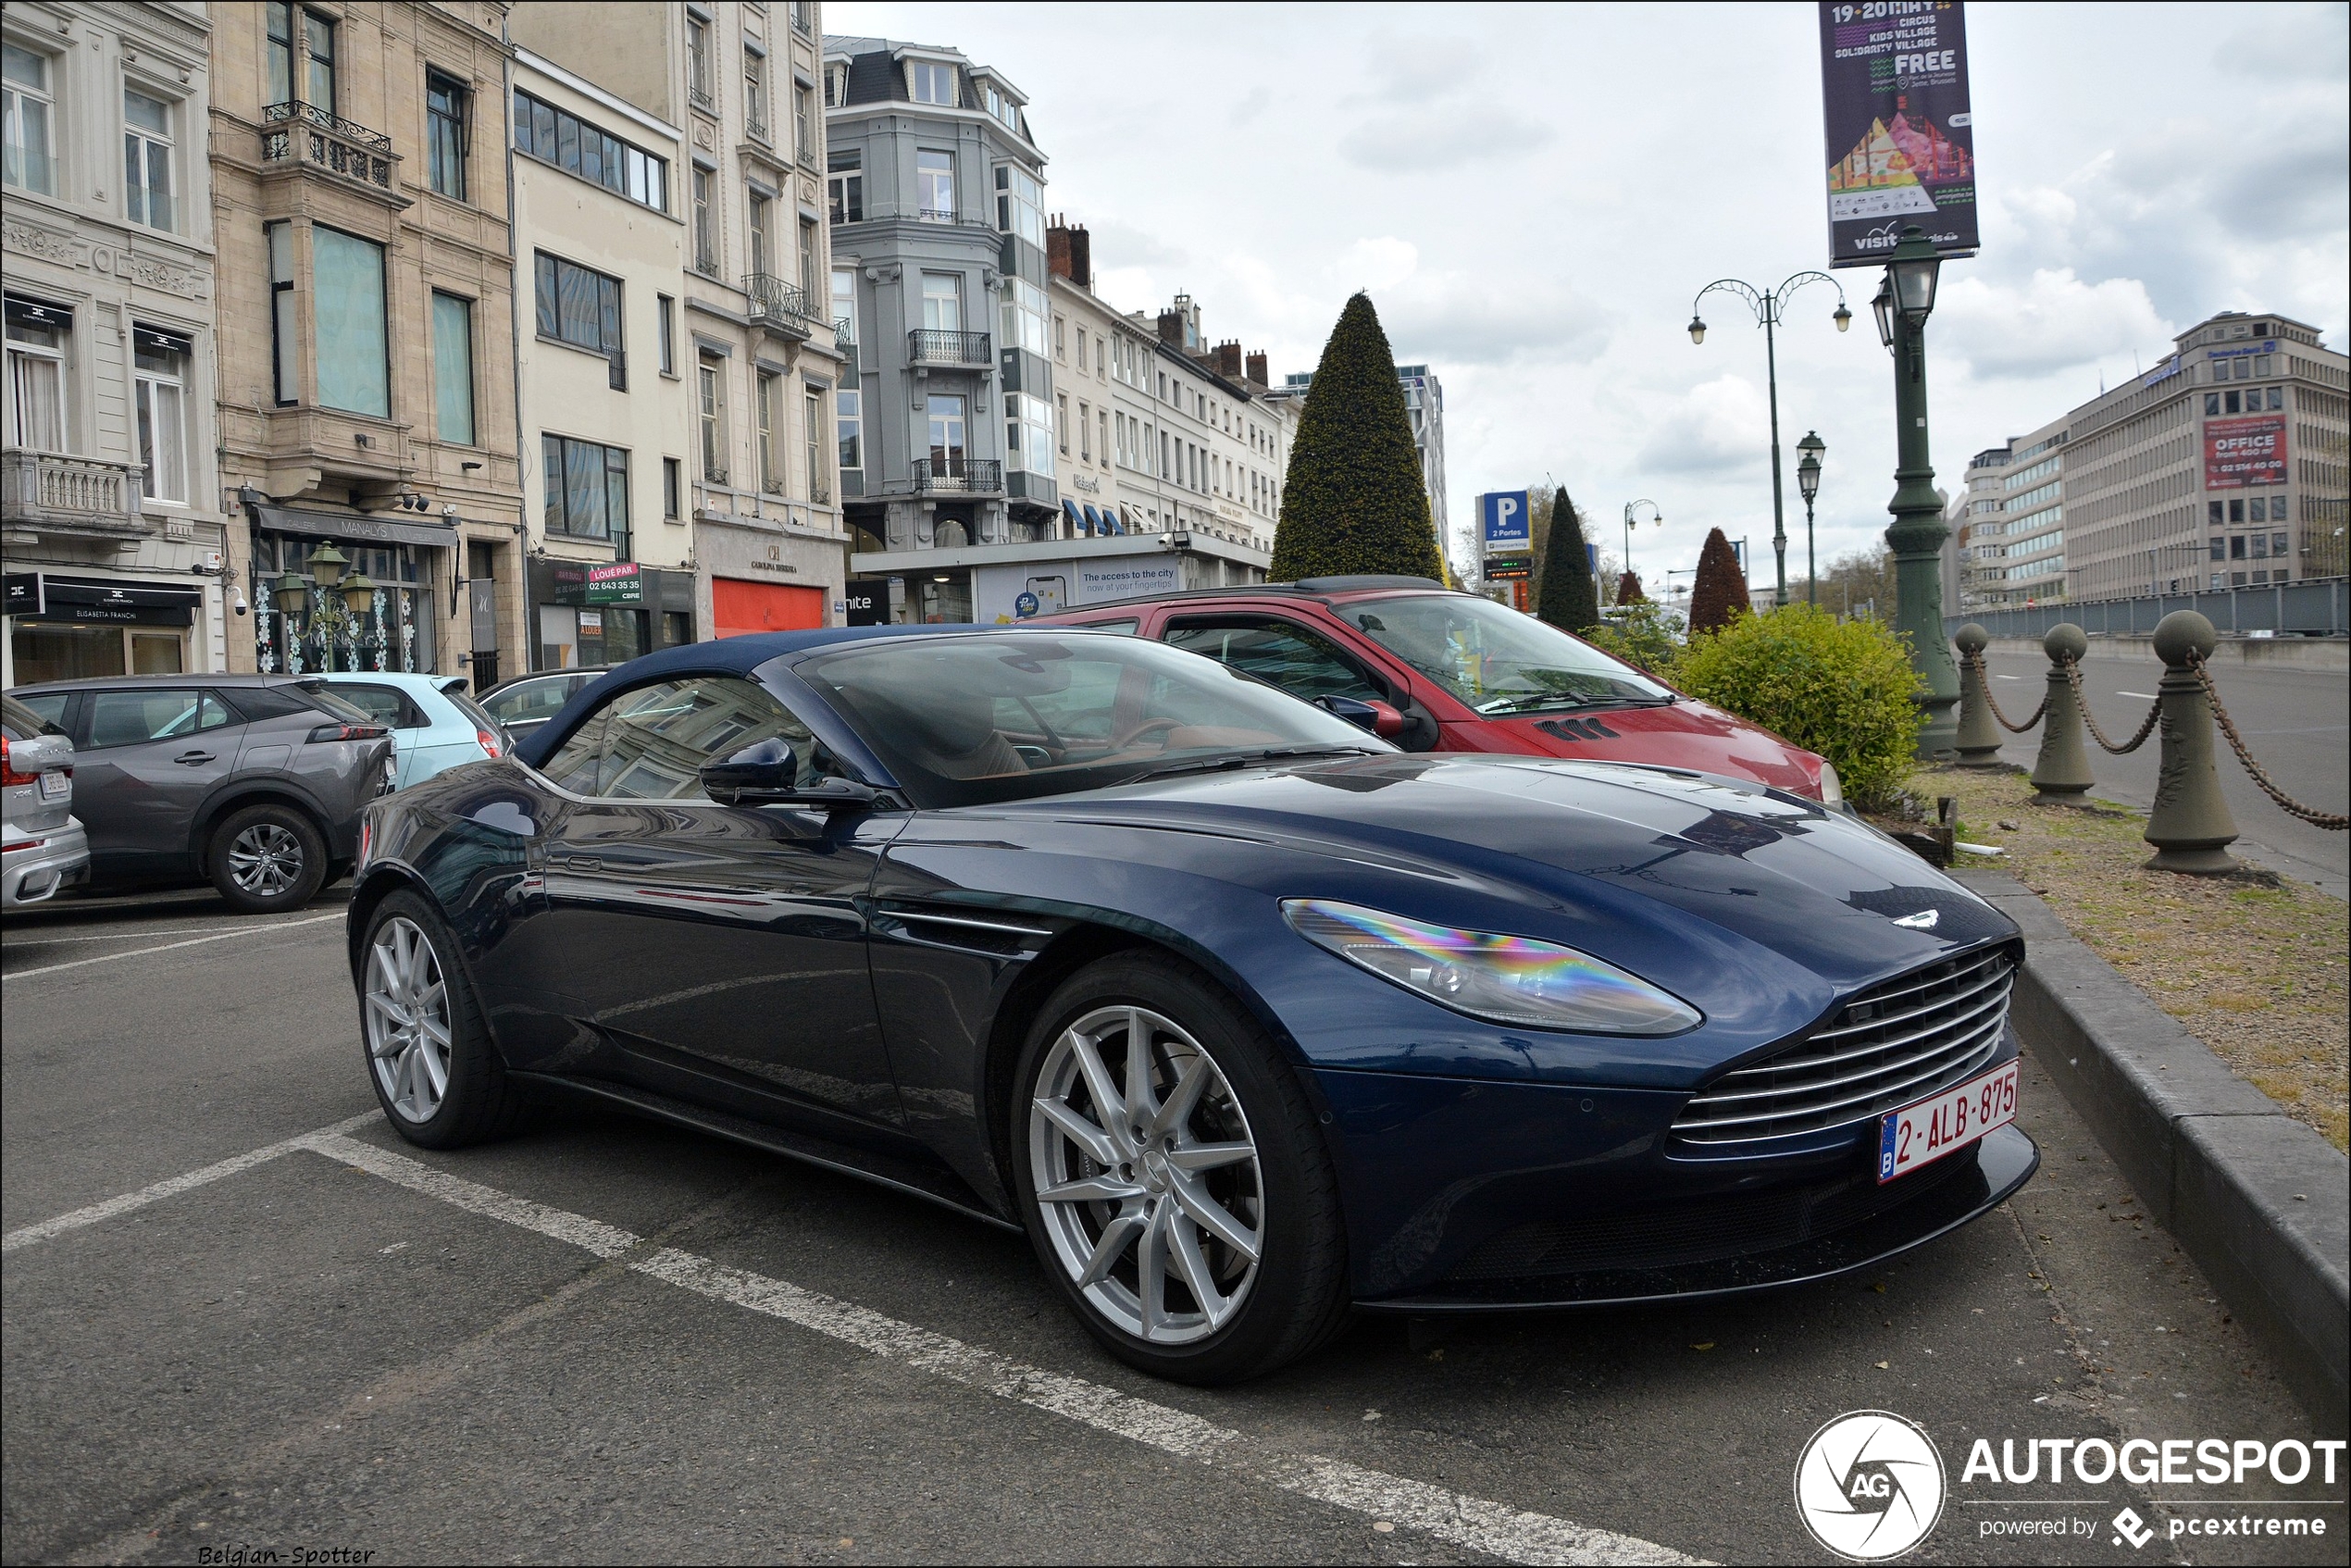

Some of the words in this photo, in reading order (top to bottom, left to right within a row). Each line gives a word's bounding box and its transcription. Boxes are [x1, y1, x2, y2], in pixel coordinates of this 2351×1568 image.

[1899, 15, 1935, 28] CIRCUS
[1869, 31, 1894, 43] KIDS
[1895, 26, 1937, 38] VILLAGE
[1835, 43, 1892, 58] SOLIDARITY
[1895, 38, 1937, 50] VILLAGE
[1895, 49, 1956, 75] FREE
[1855, 232, 1897, 250] visit
[2215, 435, 2275, 451] OFFICE
[2215, 451, 2238, 459] from
[2240, 448, 2260, 456] 400
[2220, 464, 2234, 472] 02
[2253, 461, 2267, 469] 40
[2268, 460, 2283, 468] 00
[1498, 497, 1518, 527] P
[342, 520, 388, 538] MANALYS
[594, 567, 616, 579] LOUÉ
[616, 566, 633, 576] PAR
[1083, 573, 1100, 581] The
[1101, 572, 1130, 580] access
[1142, 569, 1156, 579] the
[1158, 568, 1174, 579] city
[589, 582, 600, 591] 02
[601, 581, 616, 590] 643
[617, 581, 628, 590] 35
[629, 580, 640, 589] 35
[1115, 582, 1133, 591] your
[1135, 579, 1172, 591] fingertips
[76, 610, 109, 618] ELISABETTA
[110, 611, 137, 619] FRANCHI
[585, 625, 603, 635] LOUER
[1897, 1071, 2016, 1165] 2-ALB-875
[1882, 1151, 1893, 1175] B
